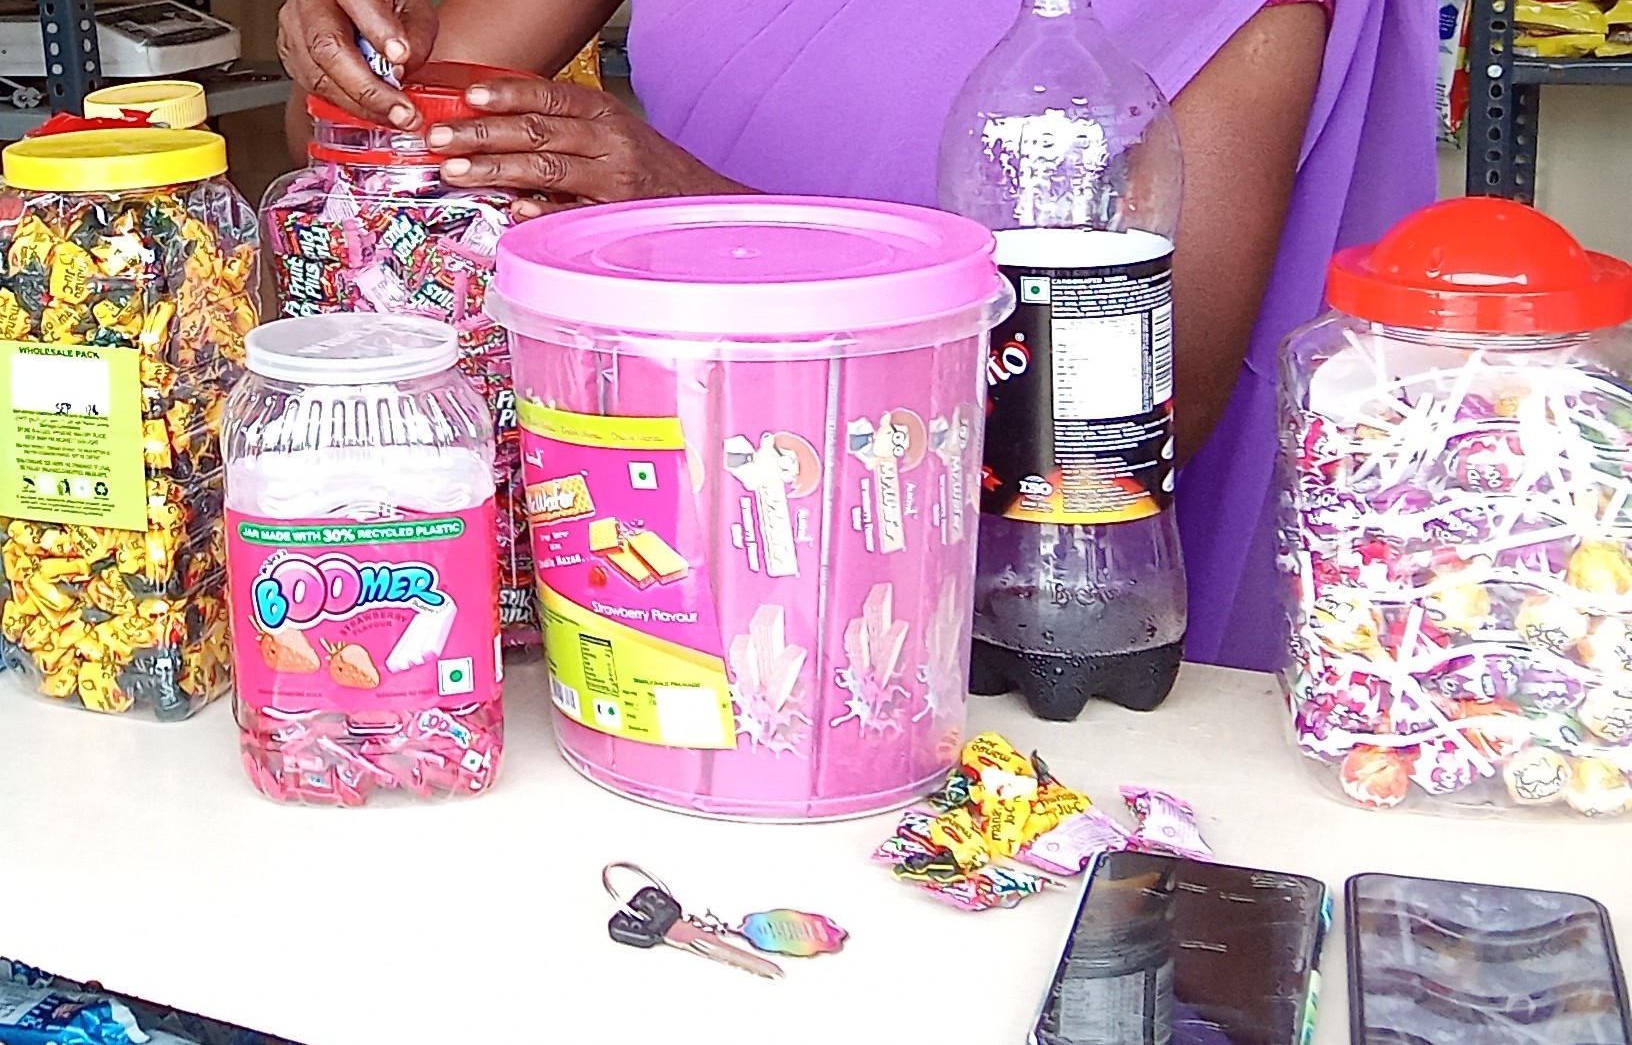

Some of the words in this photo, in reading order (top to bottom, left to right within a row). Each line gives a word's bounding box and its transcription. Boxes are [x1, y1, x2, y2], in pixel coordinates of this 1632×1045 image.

[19, 347, 74, 358] WHOLESALE
[75, 350, 100, 359] PACK
[242, 528, 259, 540] JAR
[261, 530, 292, 541] MADE
[293, 530, 321, 542] WITH
[358, 527, 414, 540] RECYCLED
[415, 523, 461, 537] PLASTIC
[254, 557, 446, 629] BOOMER
[592, 601, 650, 623] Strawberry
[652, 609, 698, 624] Flavour
[339, 611, 408, 636] STRAWBERRY
[352, 621, 394, 637] FLAVOUR
